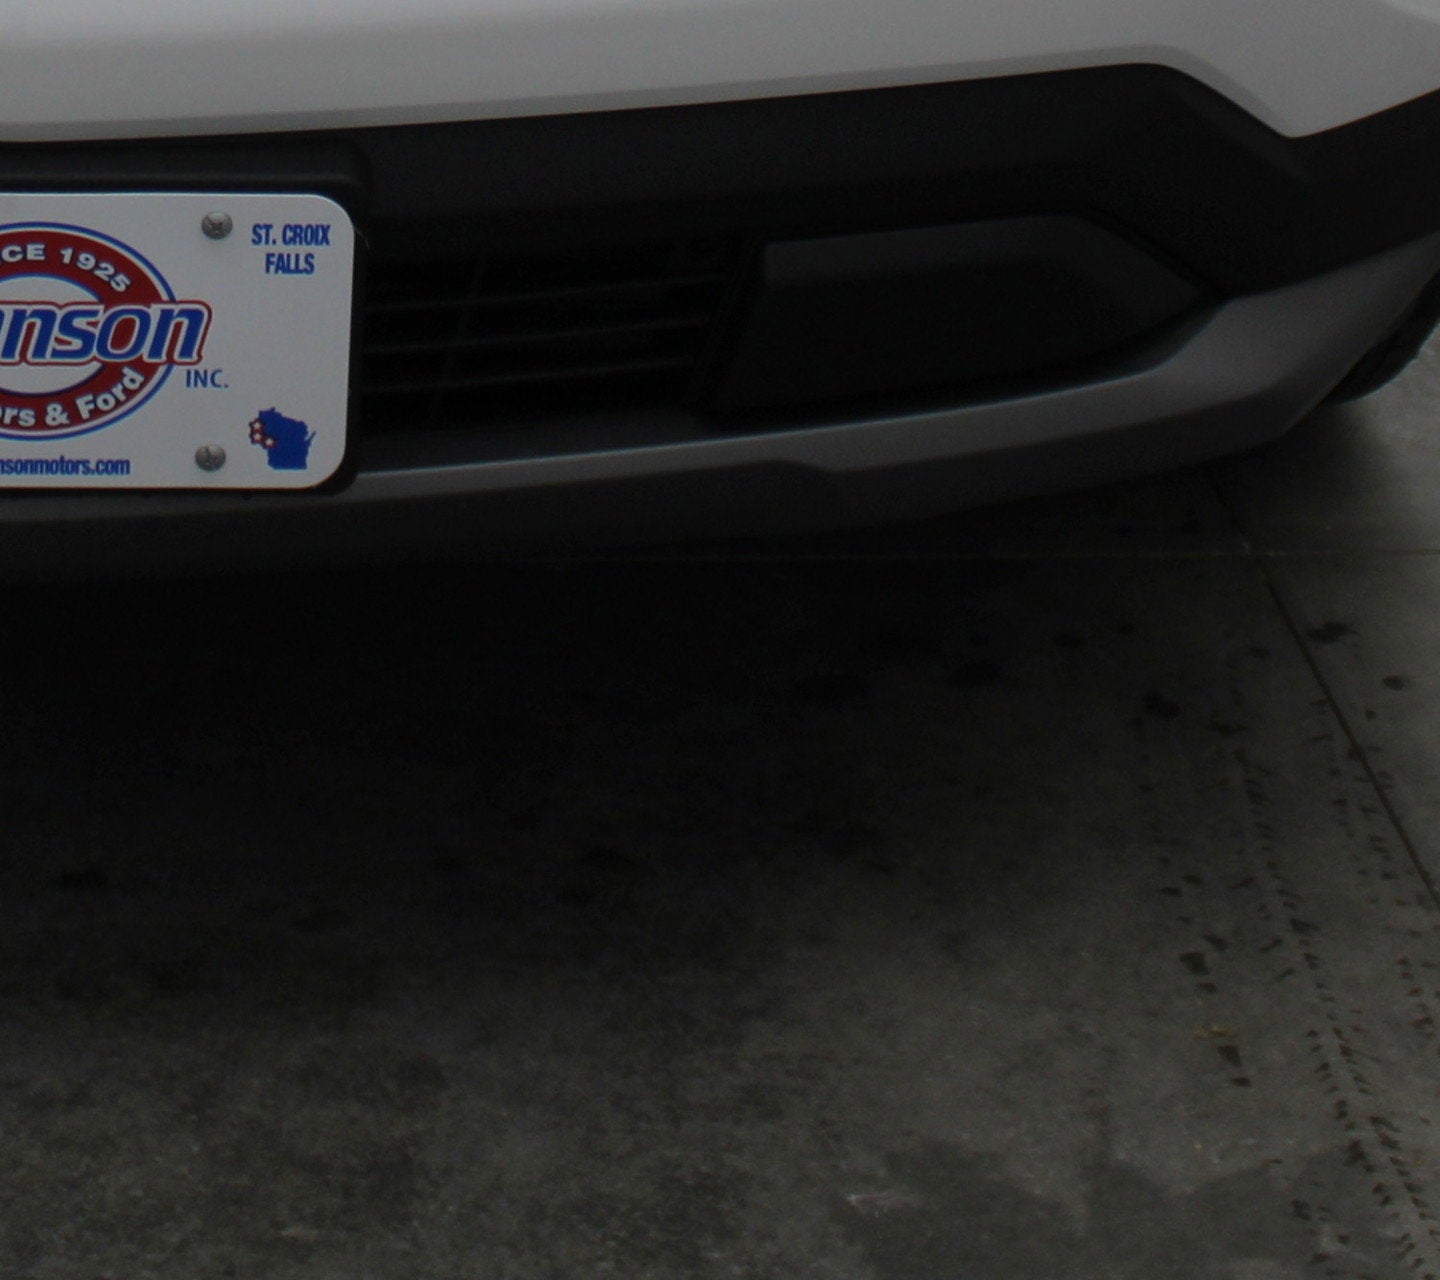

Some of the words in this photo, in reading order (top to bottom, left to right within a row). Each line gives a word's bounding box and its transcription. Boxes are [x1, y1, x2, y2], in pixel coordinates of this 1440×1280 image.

[251, 223, 278, 245] ST.
[283, 224, 331, 247] CROIX
[60, 248, 132, 292] 1925
[265, 252, 316, 275] FALLS
[185, 369, 229, 389] INC.
[46, 405, 70, 427] &
[76, 368, 146, 420] Ford
